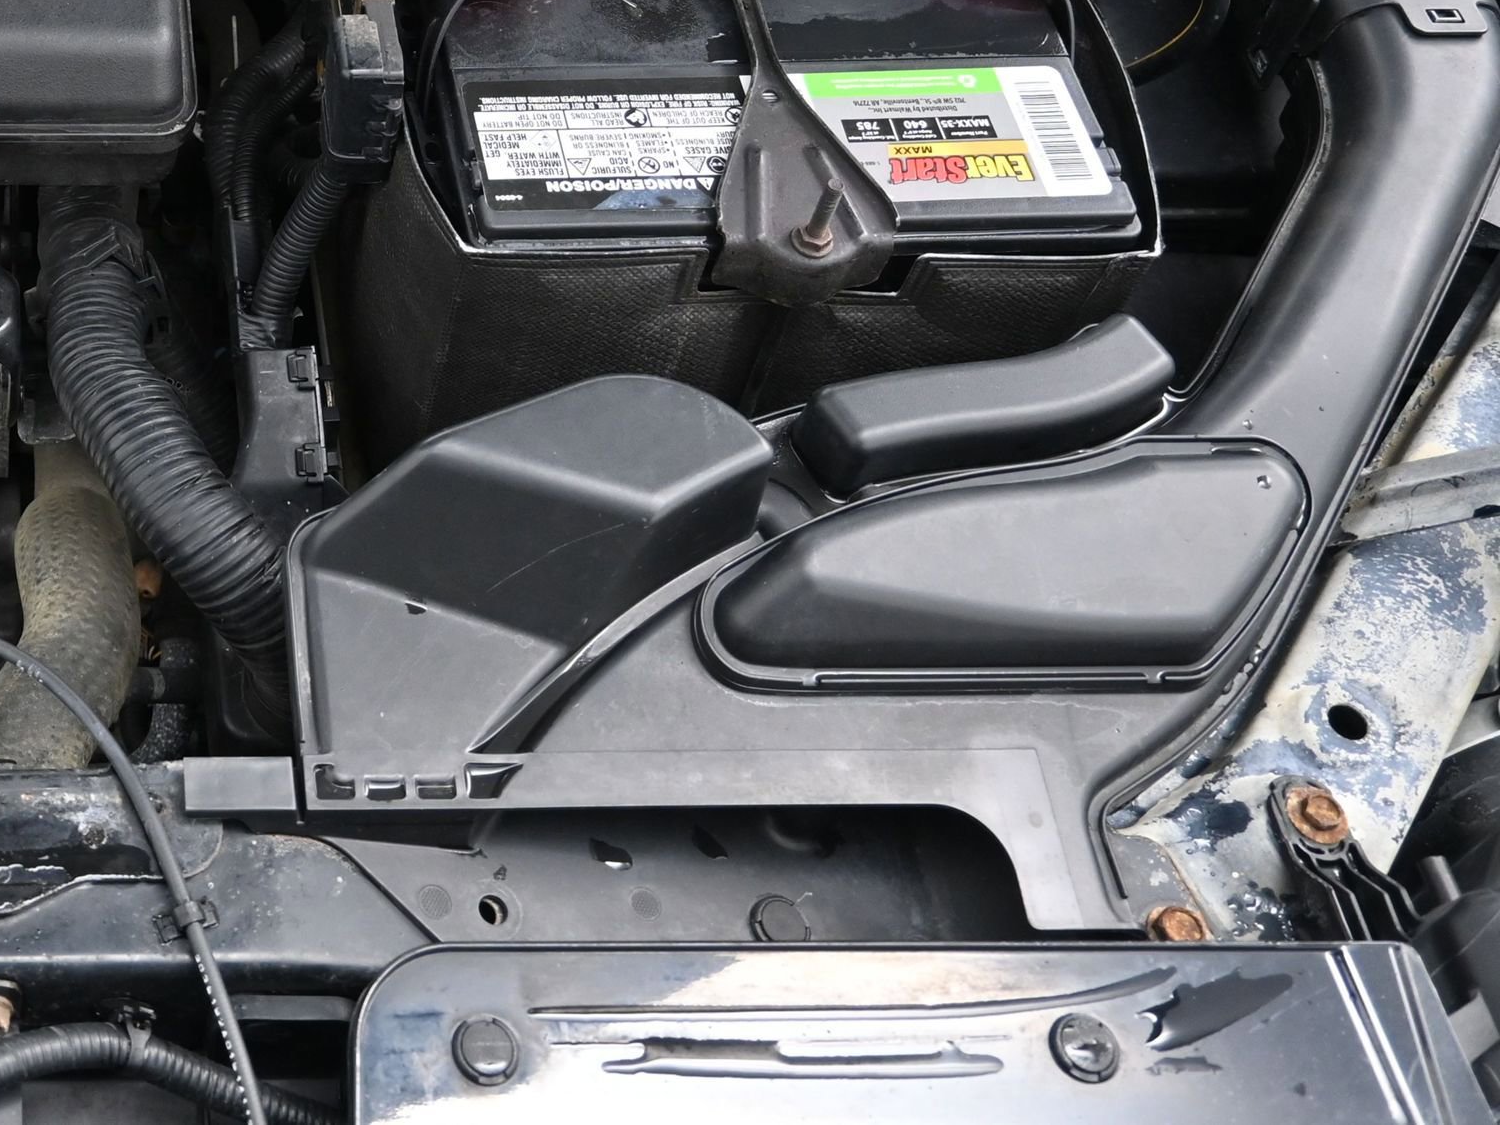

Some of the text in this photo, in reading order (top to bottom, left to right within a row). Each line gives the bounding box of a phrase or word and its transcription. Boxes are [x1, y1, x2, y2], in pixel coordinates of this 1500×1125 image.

[869, 99, 880, 107] AR
[880, 99, 920, 107] Bentonville,
[883, 106, 912, 114] Walmart
[912, 105, 921, 113] by
[921, 105, 958, 113] Distributed
[855, 121, 880, 130] 785
[903, 120, 928, 129] 640
[940, 118, 990, 129] MAXX-35
[506, 133, 526, 141] HELP
[684, 146, 712, 155] GASES
[893, 146, 933, 154] MAXX
[662, 160, 675, 169] NO
[591, 166, 632, 174] SULFURIC
[889, 154, 1035, 184] EverStart
[545, 178, 697, 192] DANGER/POISON
